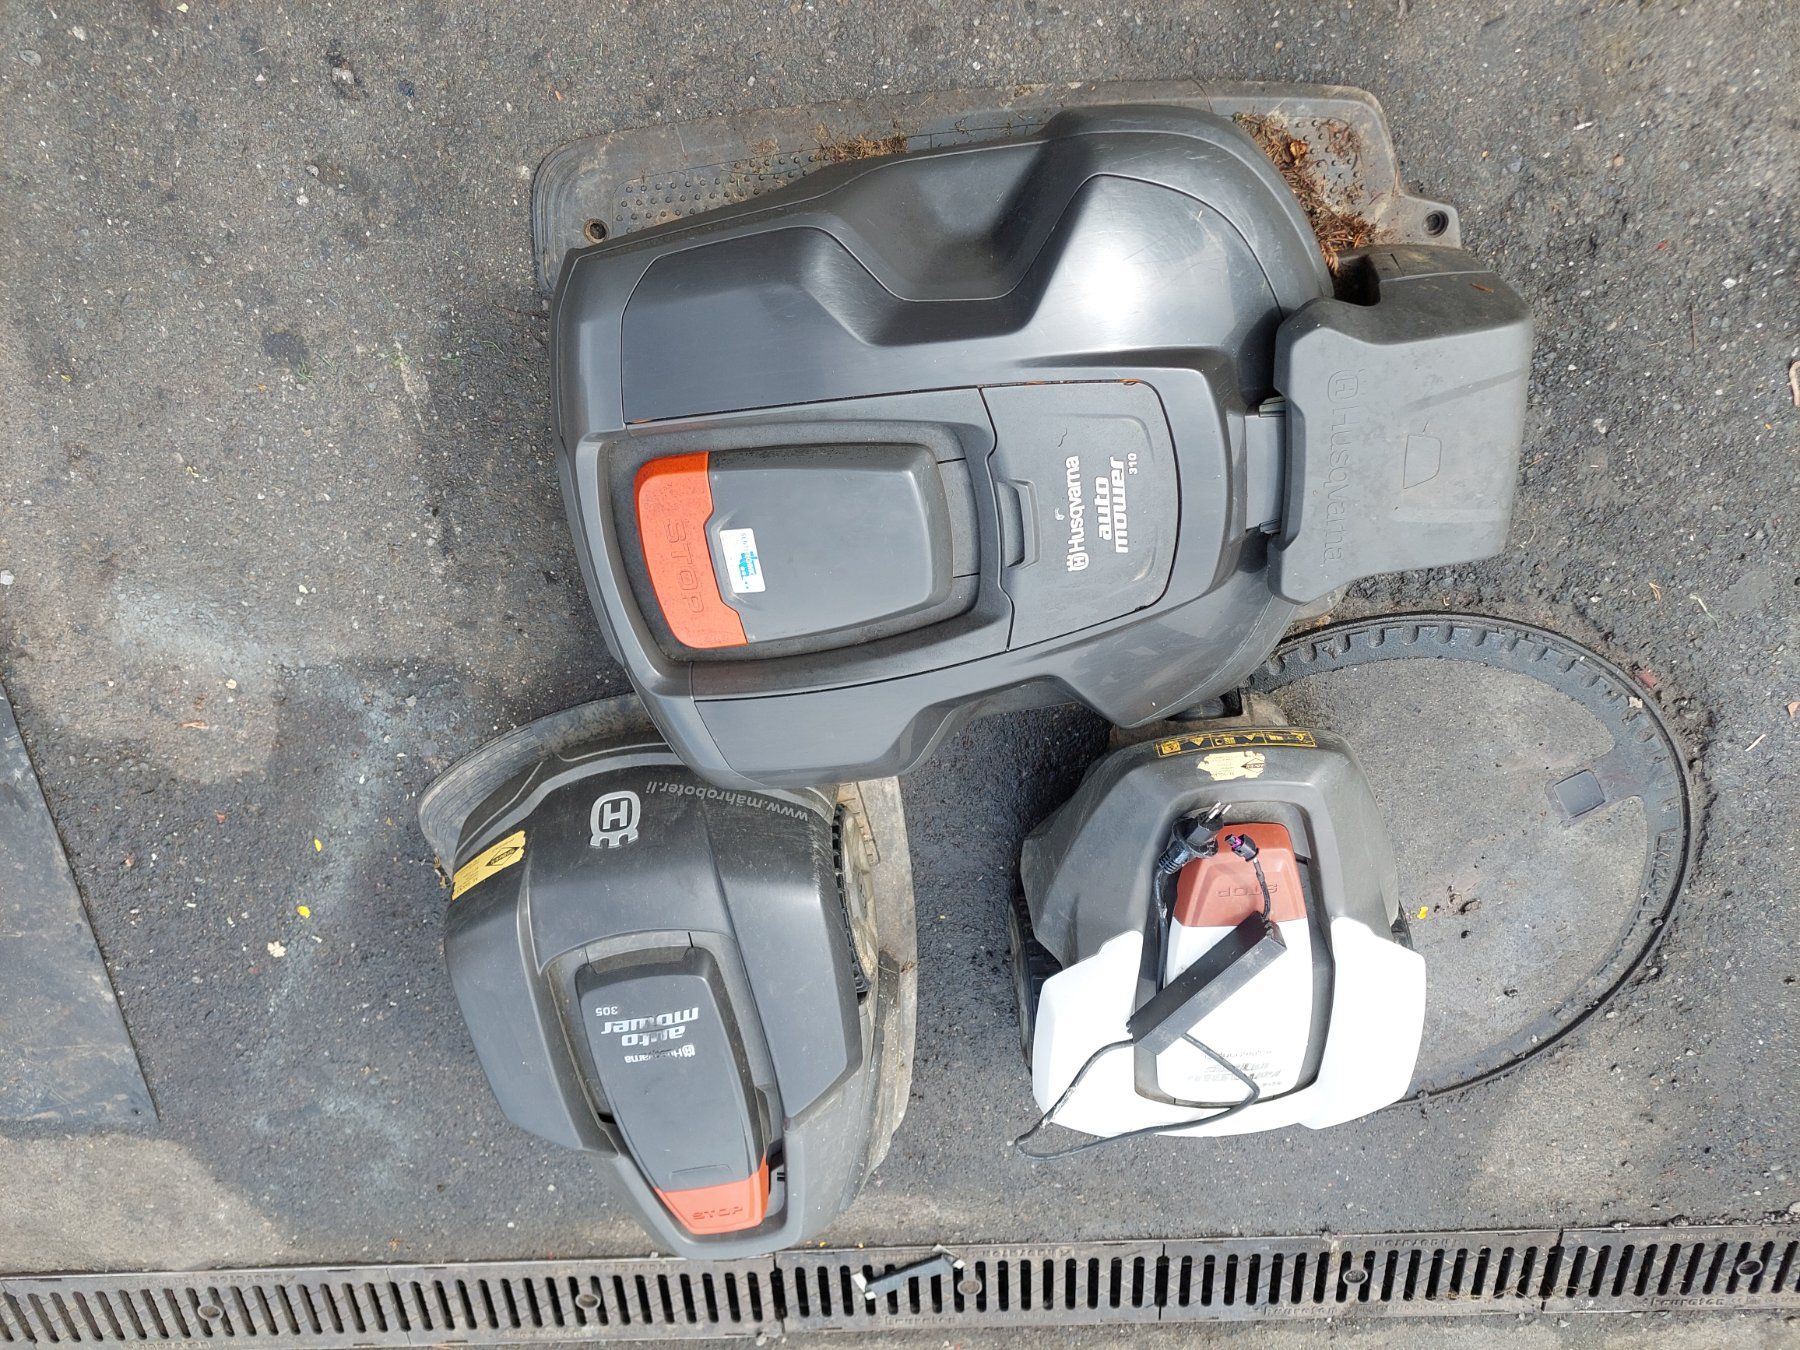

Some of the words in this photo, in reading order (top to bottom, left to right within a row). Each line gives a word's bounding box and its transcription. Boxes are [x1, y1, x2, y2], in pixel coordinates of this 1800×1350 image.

[1127, 452, 1138, 475] 310
[1065, 455, 1086, 553] Husqvarna
[1093, 476, 1112, 541] auto
[1110, 456, 1129, 554] mower
[664, 519, 704, 614] STOP
[644, 781, 809, 822] www.mähroboter.li
[1216, 883, 1279, 898] STOP
[595, 1005, 618, 1017] 305
[600, 1006, 699, 1035] mower
[620, 1025, 686, 1047] auto
[624, 1047, 683, 1064] Huvarna
[692, 1205, 743, 1220] STOP
